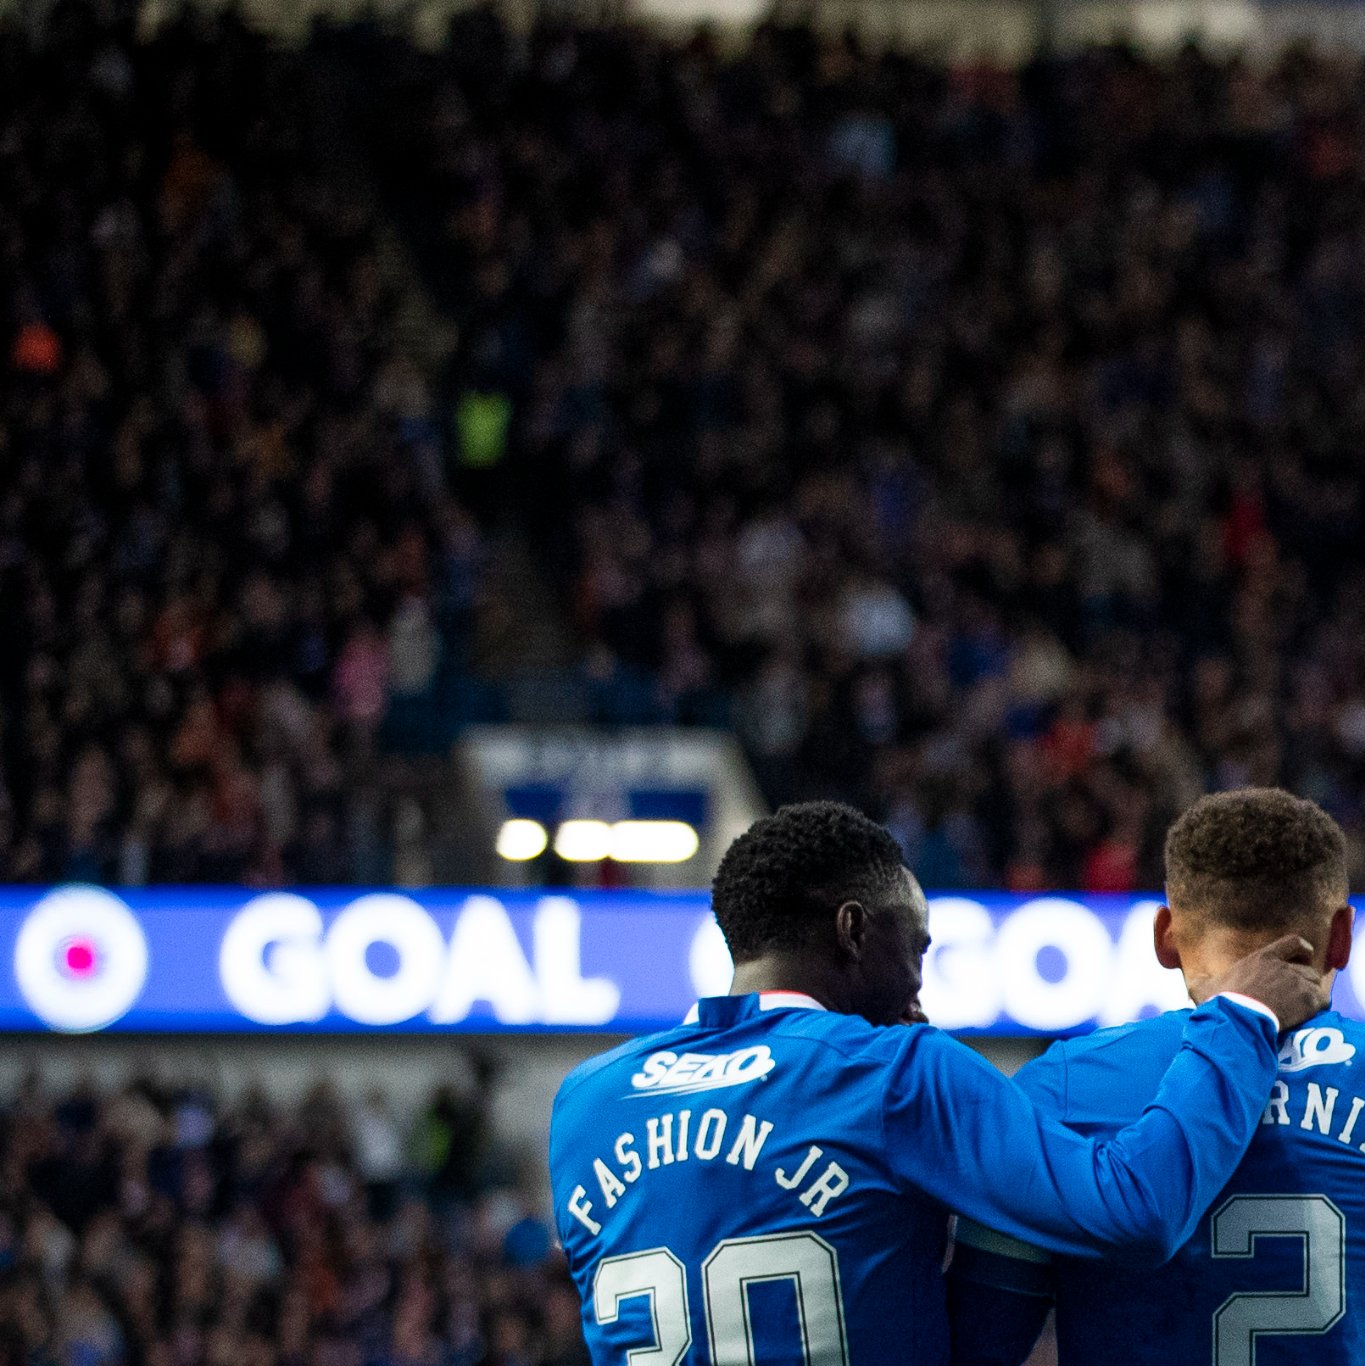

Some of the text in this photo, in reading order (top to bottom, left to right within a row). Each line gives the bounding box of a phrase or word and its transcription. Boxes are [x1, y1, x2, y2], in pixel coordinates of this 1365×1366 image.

[219, 891, 622, 1026] GOAL
[919, 896, 1195, 1029] GOA
[629, 1044, 778, 1096] SEKO
[567, 1107, 850, 1236] FASHION JR
